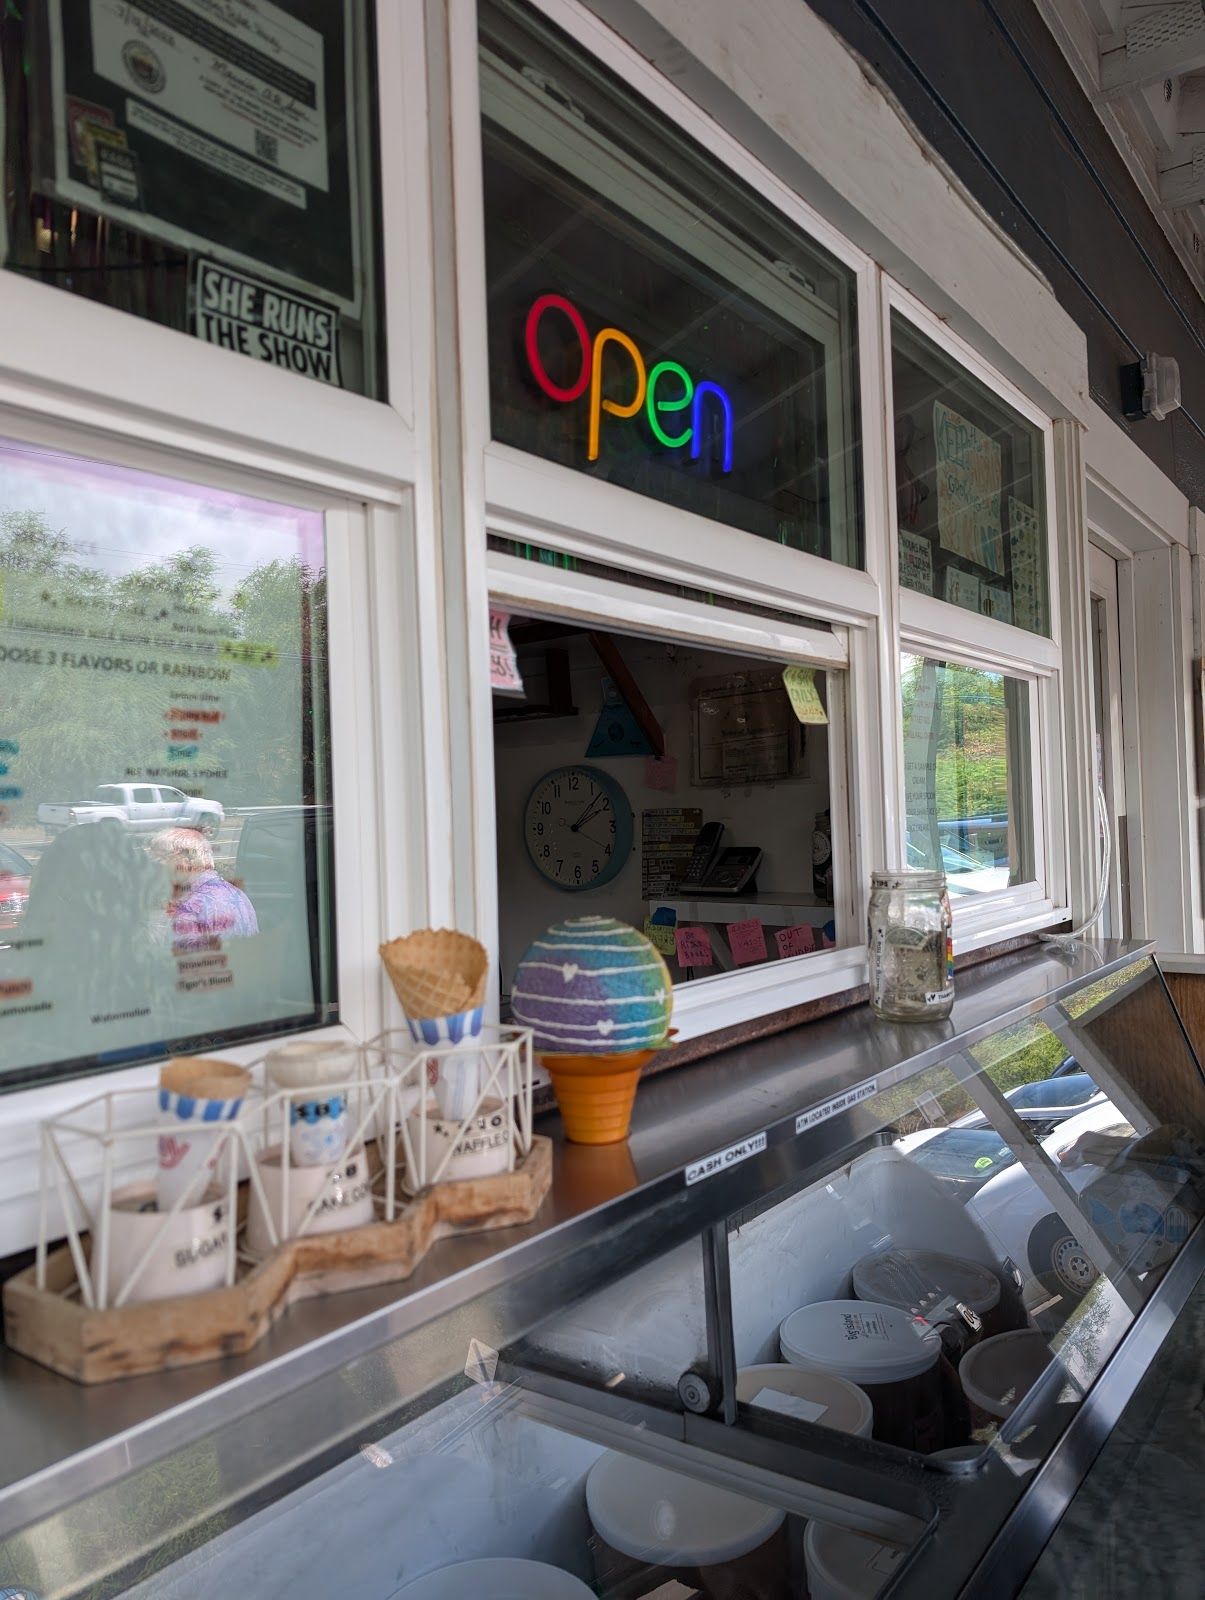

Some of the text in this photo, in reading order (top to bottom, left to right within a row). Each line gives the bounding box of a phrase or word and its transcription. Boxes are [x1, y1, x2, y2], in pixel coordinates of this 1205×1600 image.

[204, 270, 330, 348] SHE RUNS
[202, 312, 332, 381] THE SHOW
[525, 294, 733, 473] Open
[46, 650, 57, 666] 3
[61, 651, 133, 673] FLAVORS
[136, 660, 159, 675] OR
[162, 661, 232, 682] RAINBOW
[554, 784, 561, 798] 11
[568, 777, 579, 791] 12
[541, 801, 551, 815] 10
[602, 797, 610, 811] 2
[537, 822, 544, 835] 9
[609, 820, 617, 834] 3
[543, 844, 551, 857] 8
[604, 844, 612, 857] 4
[556, 859, 564, 873] 7
[574, 865, 582, 879] 6
[591, 859, 599, 873] 5
[779, 927, 803, 942] OUT
[783, 942, 794, 951] OF
[90, 1006, 151, 1025] Watermelon
[808, 1105, 831, 1122] LOCATED
[857, 1084, 875, 1099] STATION
[686, 1136, 766, 1182] CASH ONLY!!!
